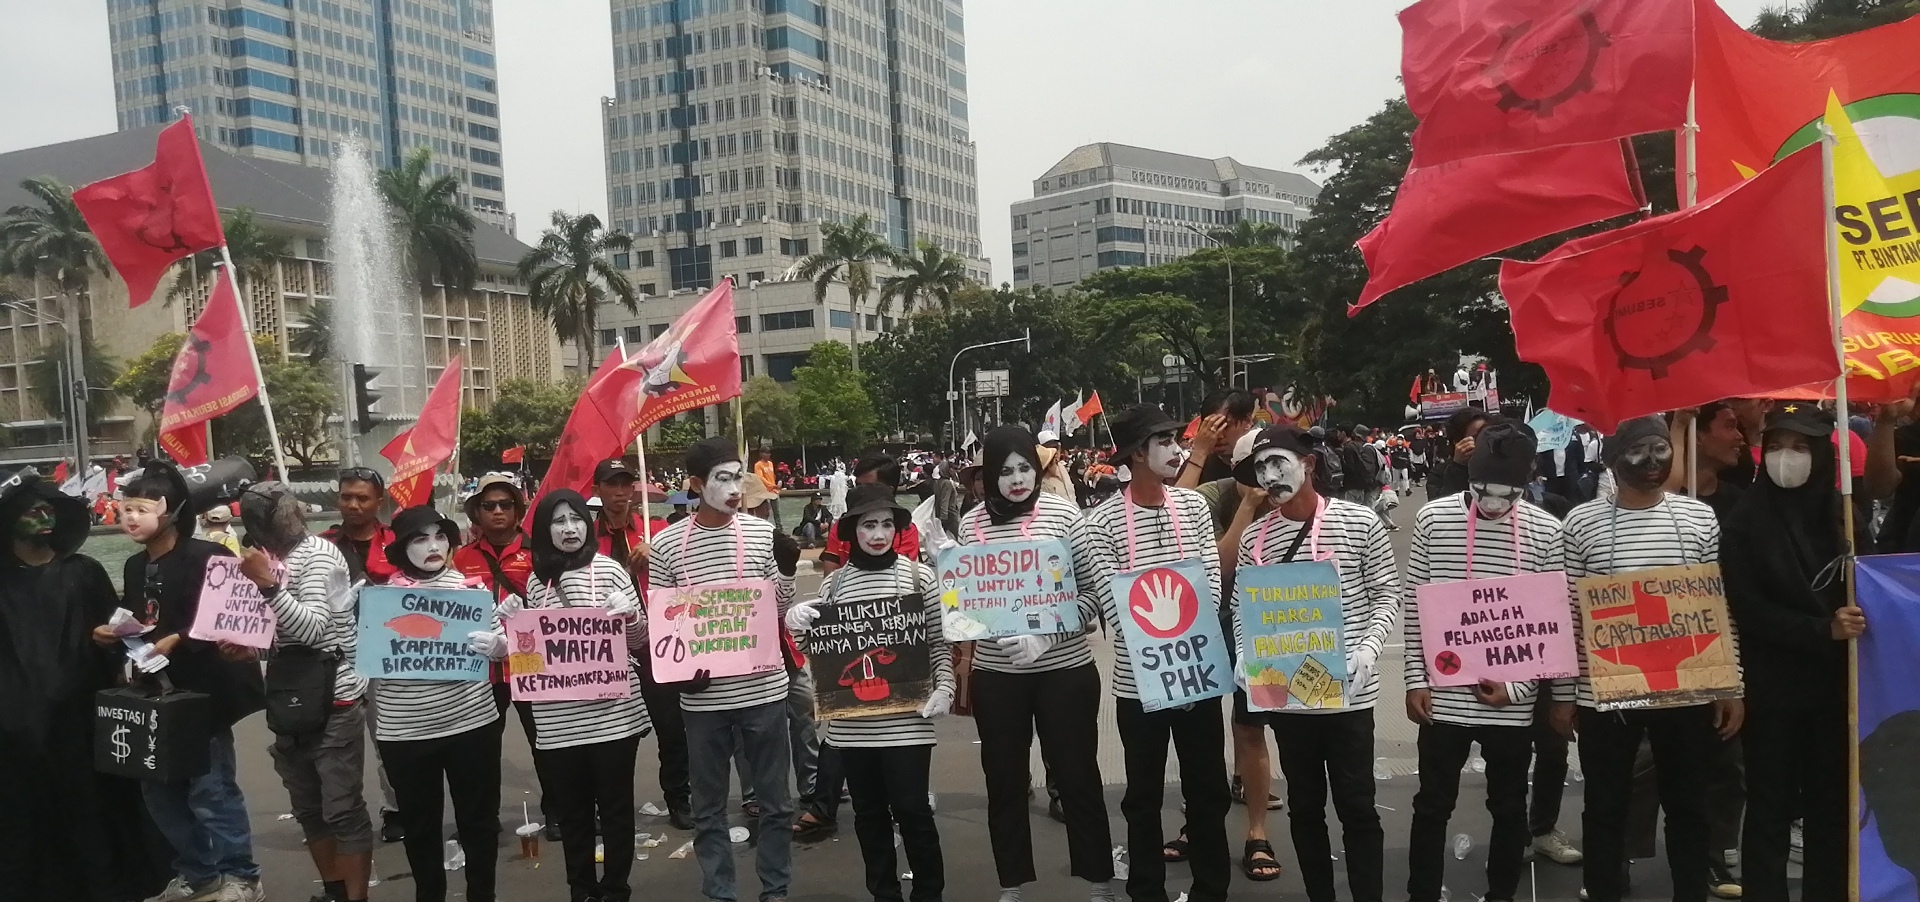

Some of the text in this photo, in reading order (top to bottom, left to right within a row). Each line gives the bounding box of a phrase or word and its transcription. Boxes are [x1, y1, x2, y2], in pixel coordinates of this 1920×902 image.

[1851, 250, 1875, 271] PT.
[162, 432, 191, 460] MILITAN
[955, 548, 1040, 579] SUBSIDI
[230, 582, 263, 598] KERJ
[700, 587, 763, 605] SEMBAKO
[976, 578, 1026, 593] UNTUK
[1245, 584, 1339, 603] TURUNKAN
[1472, 586, 1509, 604] PHK
[1588, 576, 1723, 606] HAN CURKAN
[225, 599, 267, 618] UNTUK
[401, 593, 483, 622] GANYANG
[838, 600, 901, 621] HUKUM
[963, 597, 1007, 611] PETANI
[1023, 591, 1075, 607] NELAYAN
[214, 612, 271, 634] RAKYAT
[538, 615, 623, 636] BONGKAR
[694, 616, 748, 638] UPAH
[810, 611, 926, 638] KETENAGA KERJAAN
[1261, 607, 1323, 627] HARGA
[1460, 605, 1524, 627] ADALAH
[1444, 621, 1559, 647] PELANGGARAN
[1594, 608, 1717, 650] CAPITALISME
[544, 638, 614, 665] MAFIA
[688, 634, 758, 657] DIKEBIRI
[810, 638, 852, 655] HANYA
[857, 628, 926, 651] DAGELAN
[1141, 634, 1209, 671] STOP
[1254, 631, 1336, 659] PANGAN
[516, 670, 629, 694] KETENAGAKERJAAN
[1159, 663, 1219, 702] PHK
[97, 706, 145, 725] INVESTASI
[111, 724, 131, 764] $
[143, 755, 156, 770] €
